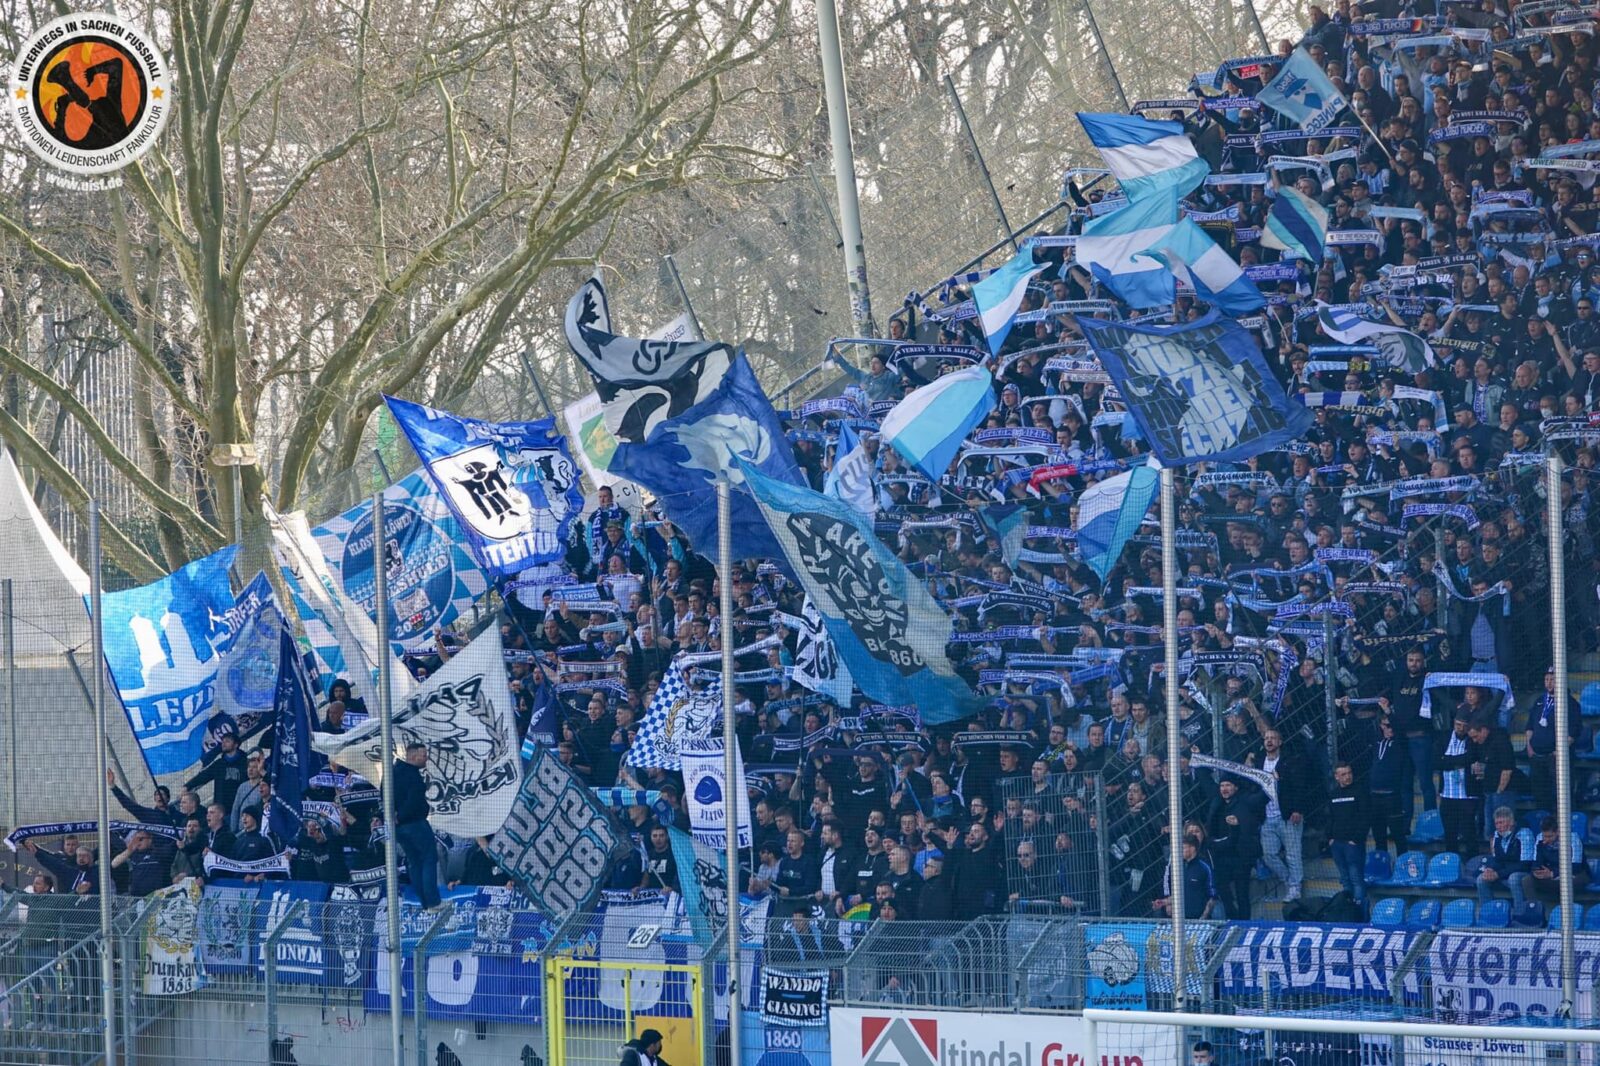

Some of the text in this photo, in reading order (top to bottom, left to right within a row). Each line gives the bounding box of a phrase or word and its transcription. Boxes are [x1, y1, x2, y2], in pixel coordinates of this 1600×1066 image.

[693, 830, 750, 849] PRESENE
[633, 927, 652, 944] 26
[1223, 926, 1424, 996] HADERN
[767, 976, 821, 992] WAMBO
[766, 1030, 801, 1048] 1860
[1041, 1042, 1144, 1066] Grup
